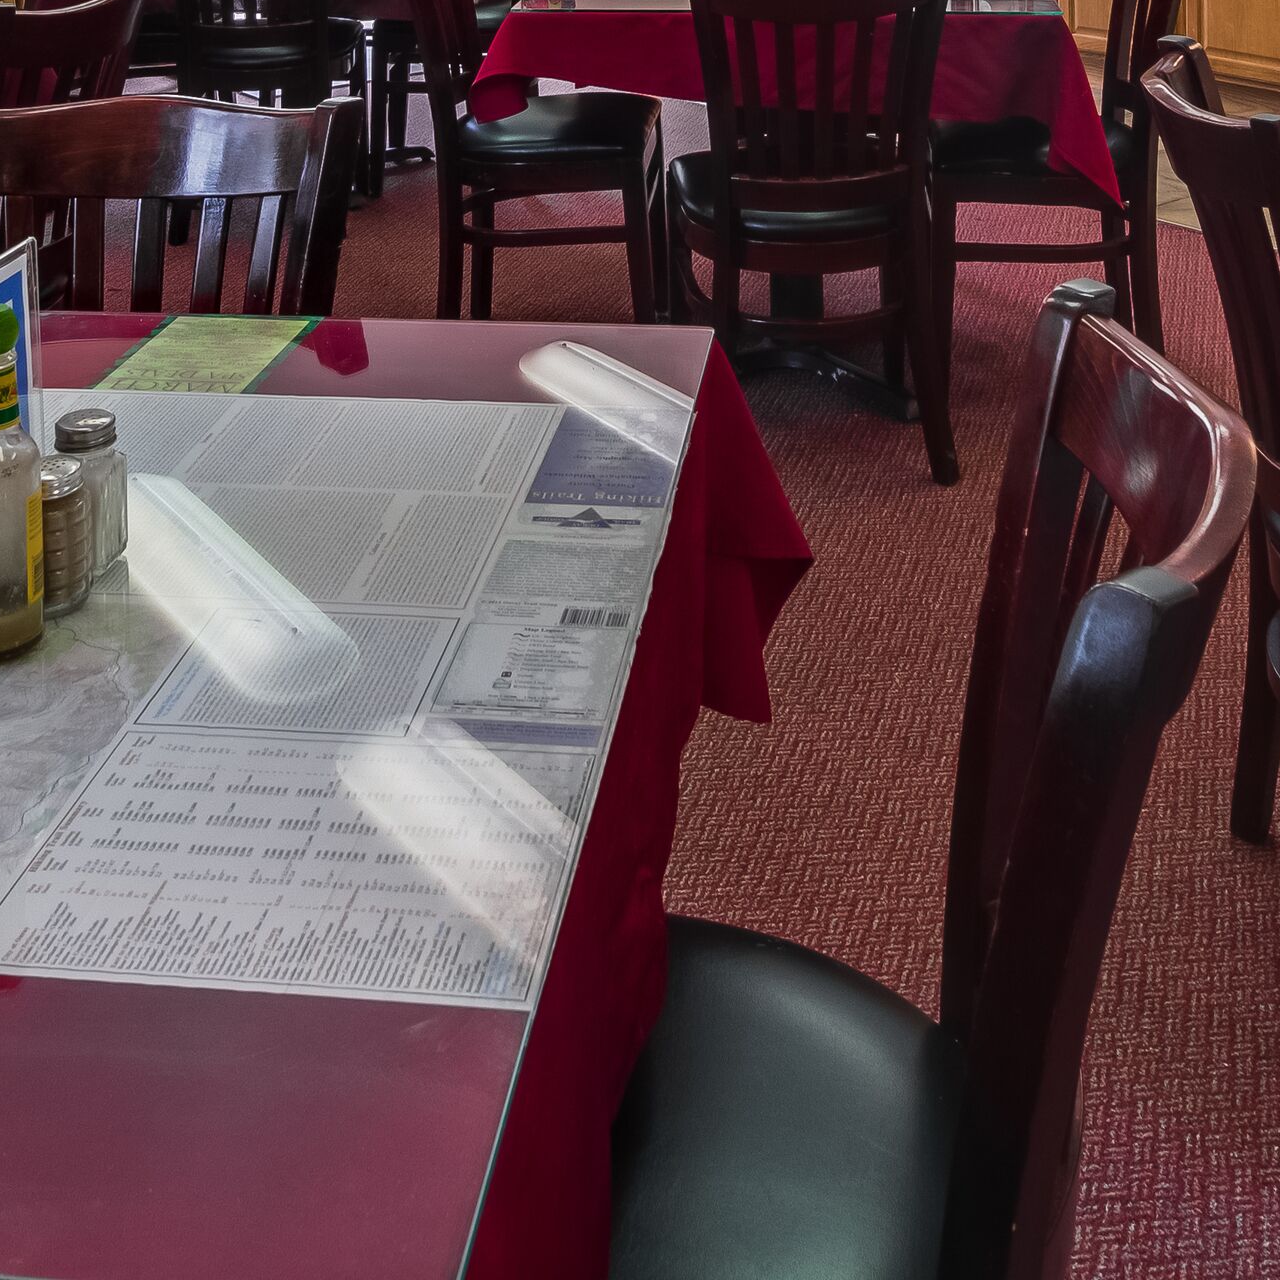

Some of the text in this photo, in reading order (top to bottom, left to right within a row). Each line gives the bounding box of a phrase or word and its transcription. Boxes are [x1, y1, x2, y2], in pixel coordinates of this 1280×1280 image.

[110, 379, 237, 394] MARCH
[531, 491, 663, 504] Hiking Trails
